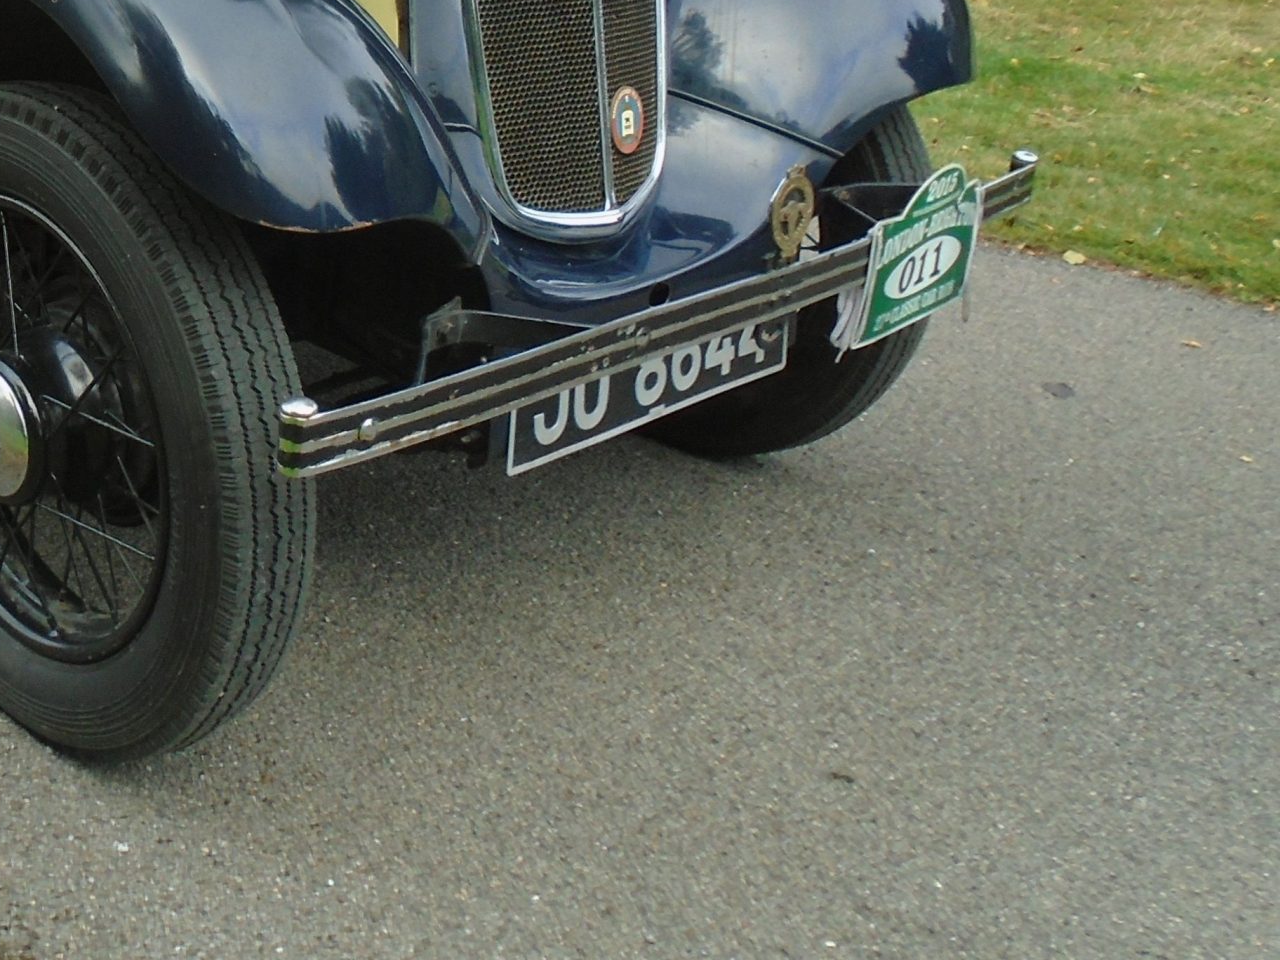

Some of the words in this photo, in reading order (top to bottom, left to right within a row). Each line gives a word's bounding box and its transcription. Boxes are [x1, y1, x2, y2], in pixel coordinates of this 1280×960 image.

[926, 171, 959, 202] 2015
[899, 242, 942, 293] 011
[533, 376, 610, 446] JU
